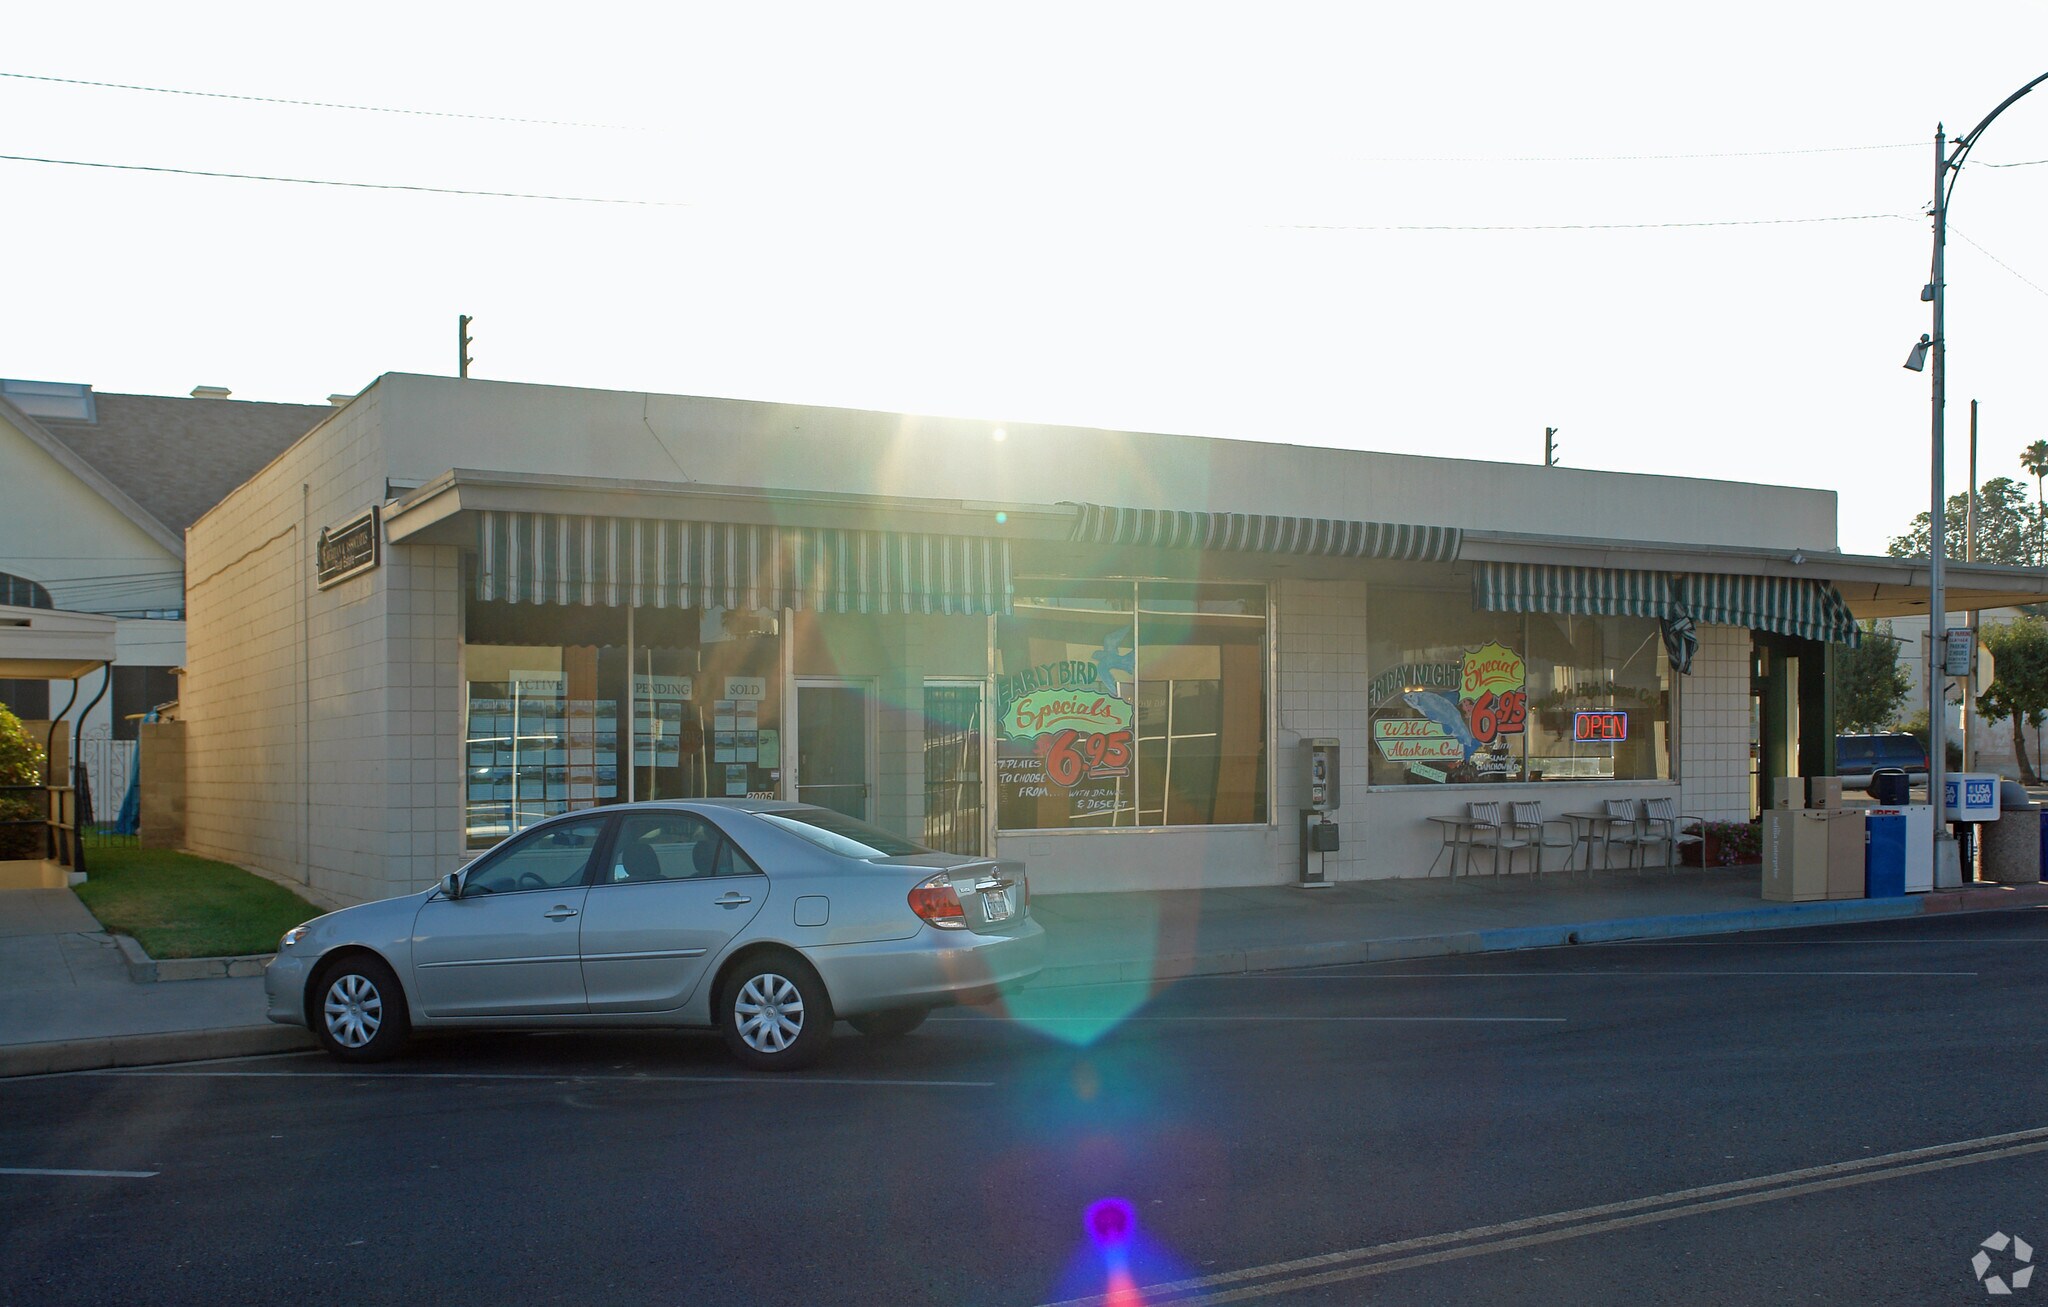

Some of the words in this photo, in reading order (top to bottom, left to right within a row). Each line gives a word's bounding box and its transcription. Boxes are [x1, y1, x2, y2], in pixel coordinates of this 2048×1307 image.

[1464, 652, 1522, 692] Special
[517, 679, 564, 691] ACTIVE
[635, 683, 690, 695] PENDING
[729, 684, 760, 695] SOLD
[996, 663, 1056, 713] EARLY
[1058, 660, 1098, 685] BIRD
[1367, 665, 1409, 706] FRIDAY
[1412, 664, 1462, 686] NIGHT
[1576, 681, 1602, 699] High
[1016, 695, 1123, 731] Specials
[1383, 721, 1439, 737] Wild
[1576, 714, 1626, 739] OPEN
[1387, 740, 1438, 758] Alaskan
[1440, 741, 1463, 757] Cod
[1006, 760, 1043, 769] PLATES
[1000, 773, 1012, 784] TO
[1013, 773, 1047, 784] CHOOSE
[1068, 789, 1090, 798] WITH
[1975, 784, 1991, 794] USA
[748, 792, 773, 800] 2006
[1967, 794, 1992, 804] TODAY
